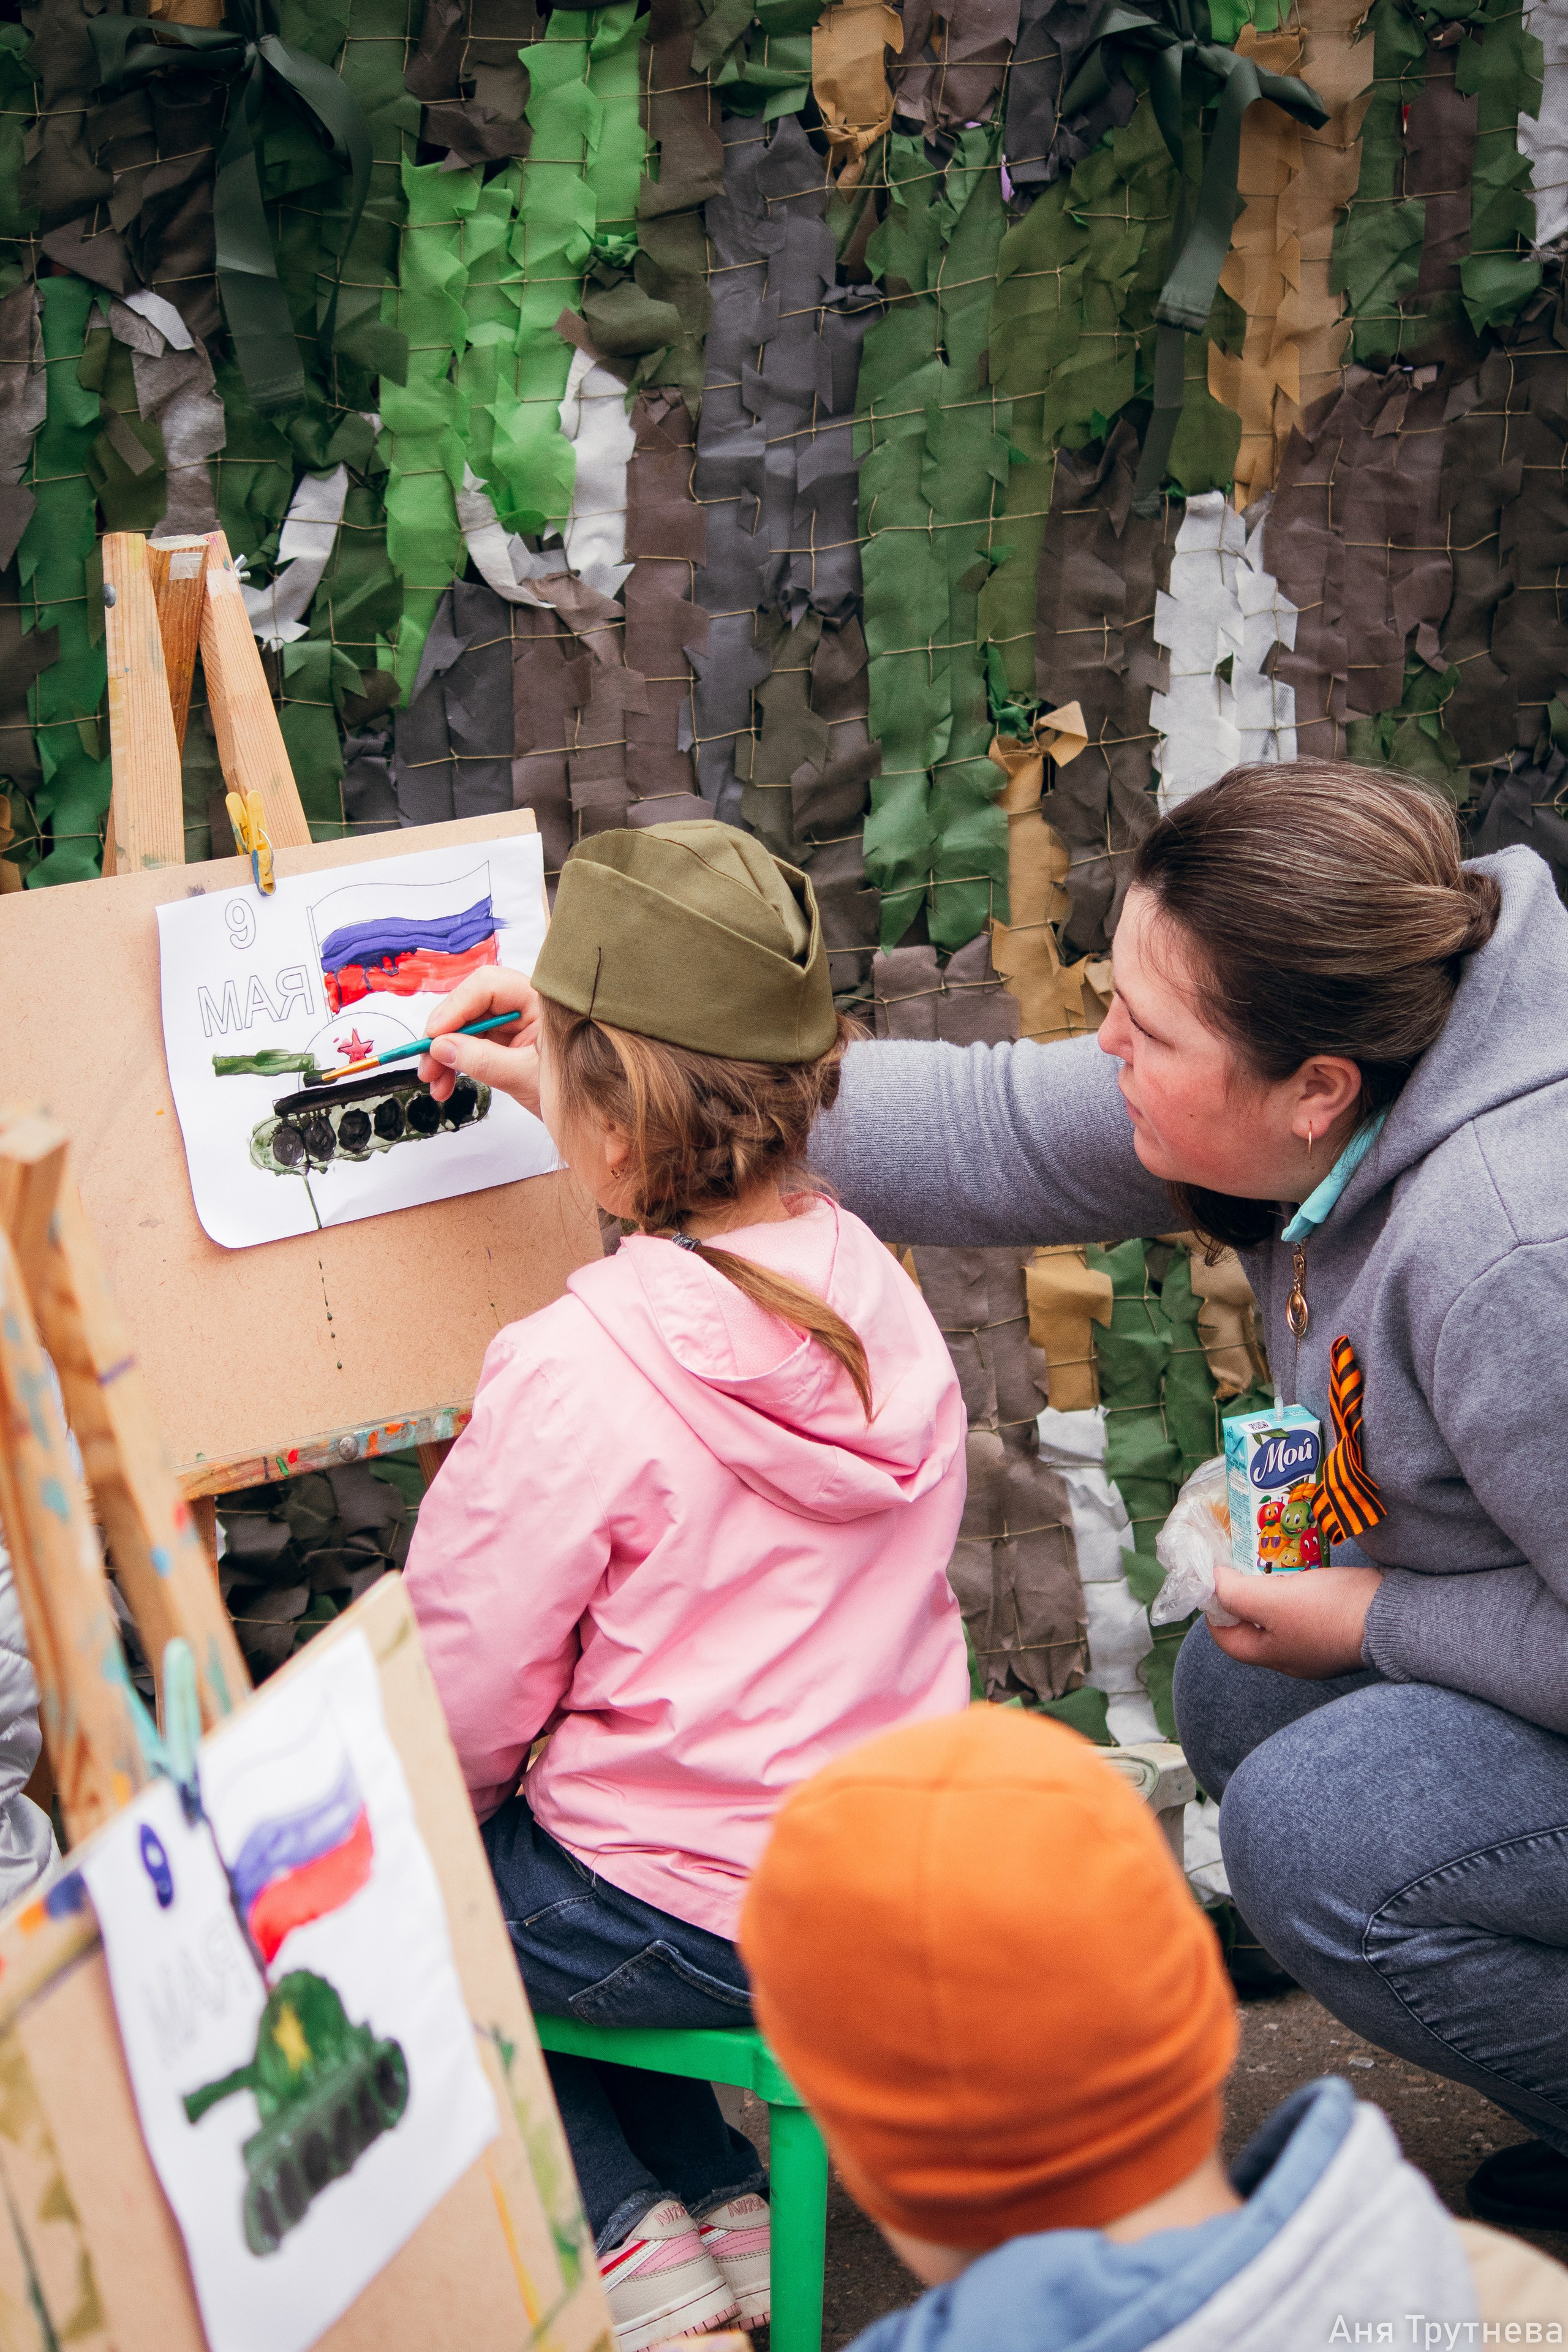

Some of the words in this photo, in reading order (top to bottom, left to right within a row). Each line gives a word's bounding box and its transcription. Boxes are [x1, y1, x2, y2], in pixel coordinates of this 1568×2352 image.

[225, 898, 255, 949] 9
[197, 965, 314, 1037] МАЯ
[1253, 1438, 1313, 1482] Мой
